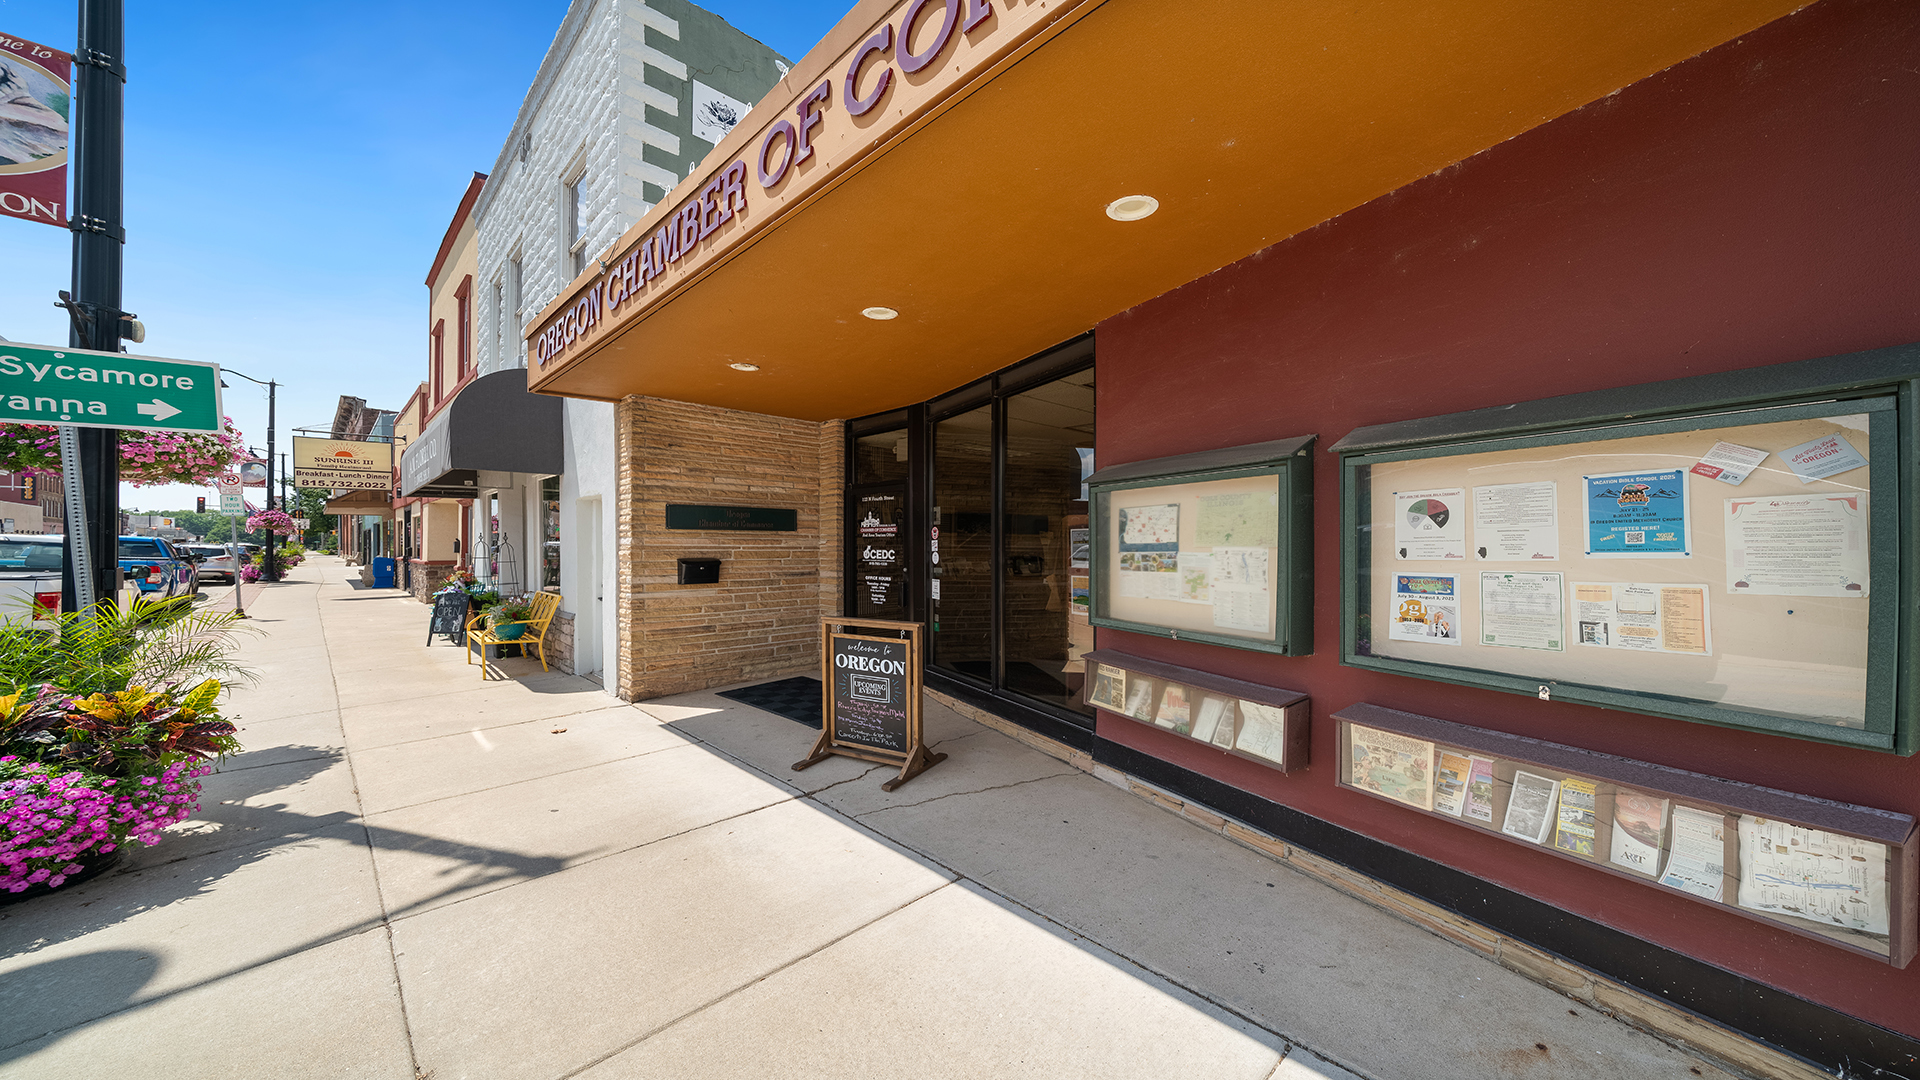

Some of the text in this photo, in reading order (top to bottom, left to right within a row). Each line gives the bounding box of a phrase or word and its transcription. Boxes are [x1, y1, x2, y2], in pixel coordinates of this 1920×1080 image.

[31, 44, 52, 58] to
[536, 0, 993, 367] OREGON CHAMBER OF CO
[0, 355, 194, 390] Sycamore
[314, 457, 360, 465] SUNRISE
[1802, 448, 1839, 464] OREGON
[301, 479, 387, 489] 815.732.2022
[437, 607, 461, 617] OPEN
[847, 641, 879, 653] welcome
[835, 653, 905, 676] OREGON
[854, 681, 886, 691] UPCOMING
[859, 687, 881, 696] EVENTS
